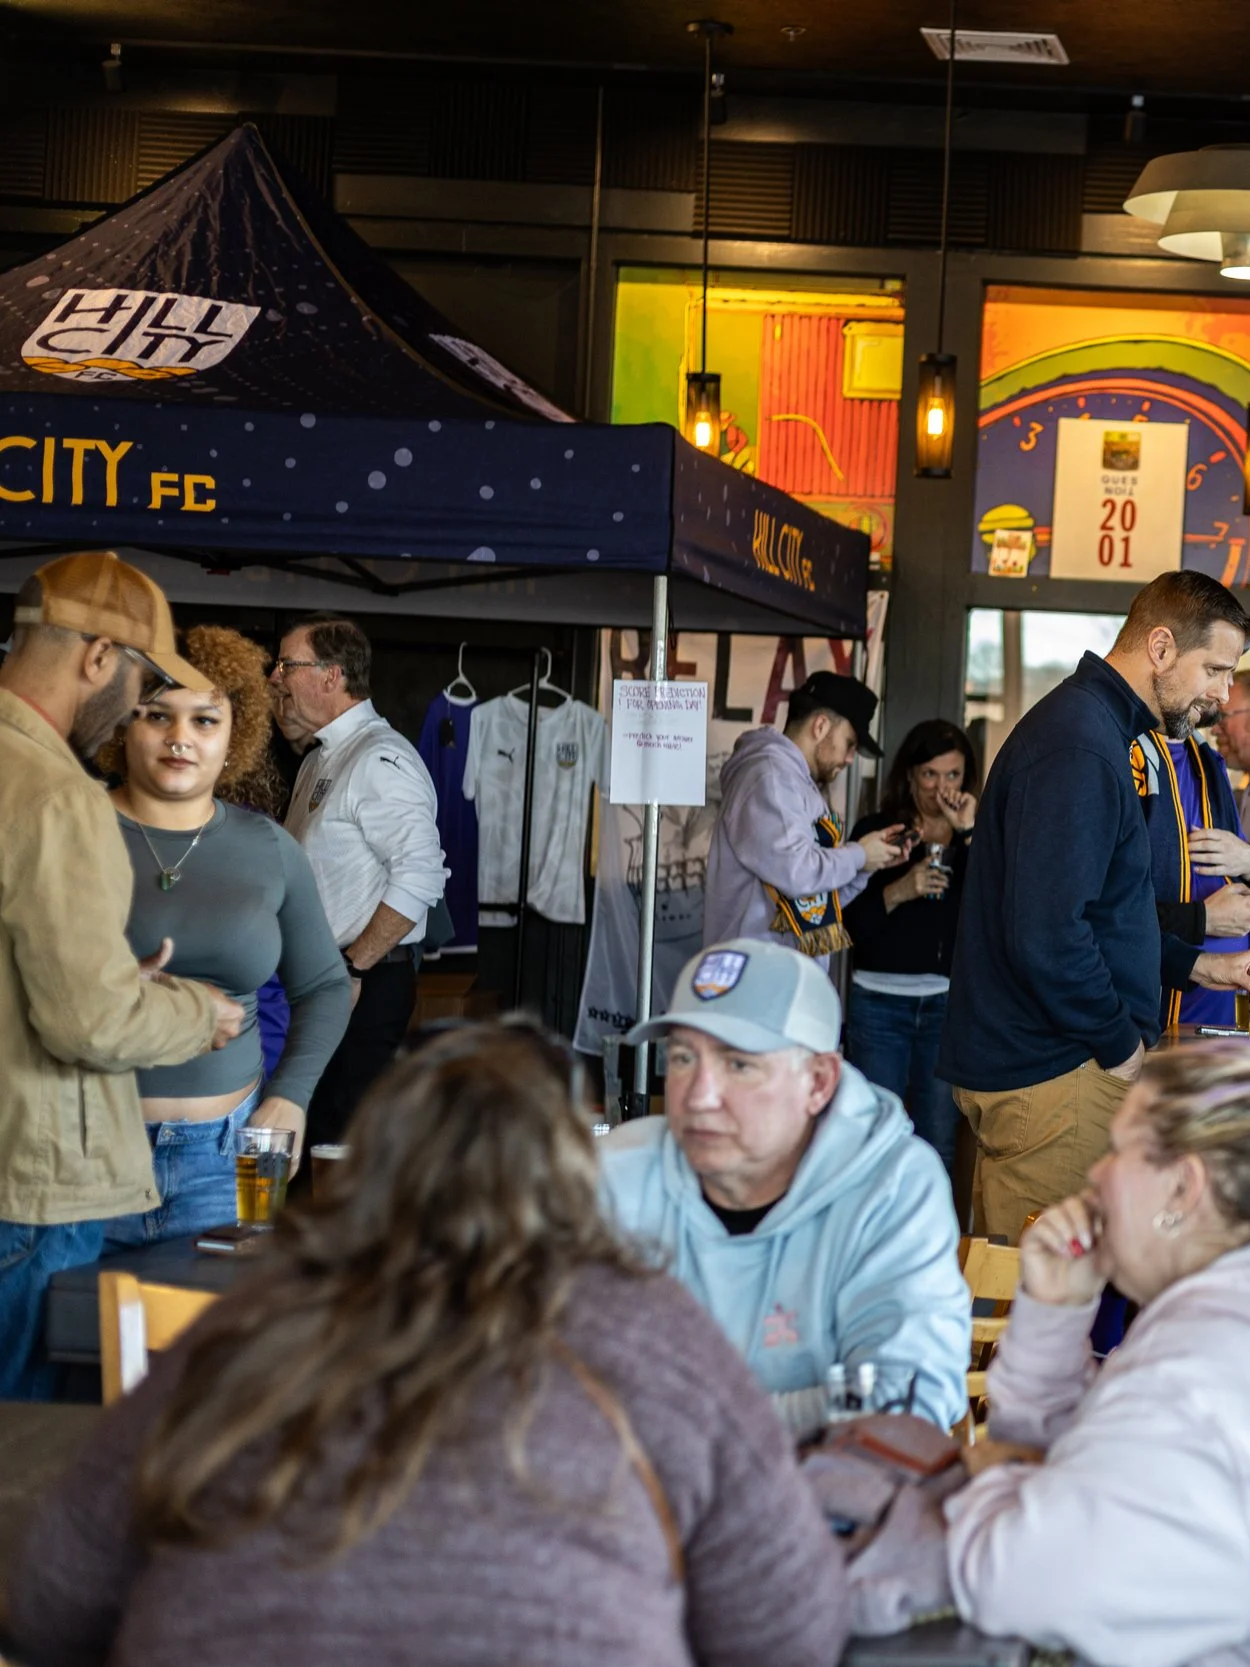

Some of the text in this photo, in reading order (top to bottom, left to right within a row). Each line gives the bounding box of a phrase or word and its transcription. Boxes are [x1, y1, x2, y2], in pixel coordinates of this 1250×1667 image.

[53, 293, 233, 342] HILL
[36, 326, 226, 364] CITY
[0, 435, 217, 513] CITY FC
[1100, 499, 1136, 532] 20
[1098, 533, 1132, 568] 01
[610, 627, 875, 724] RLA
